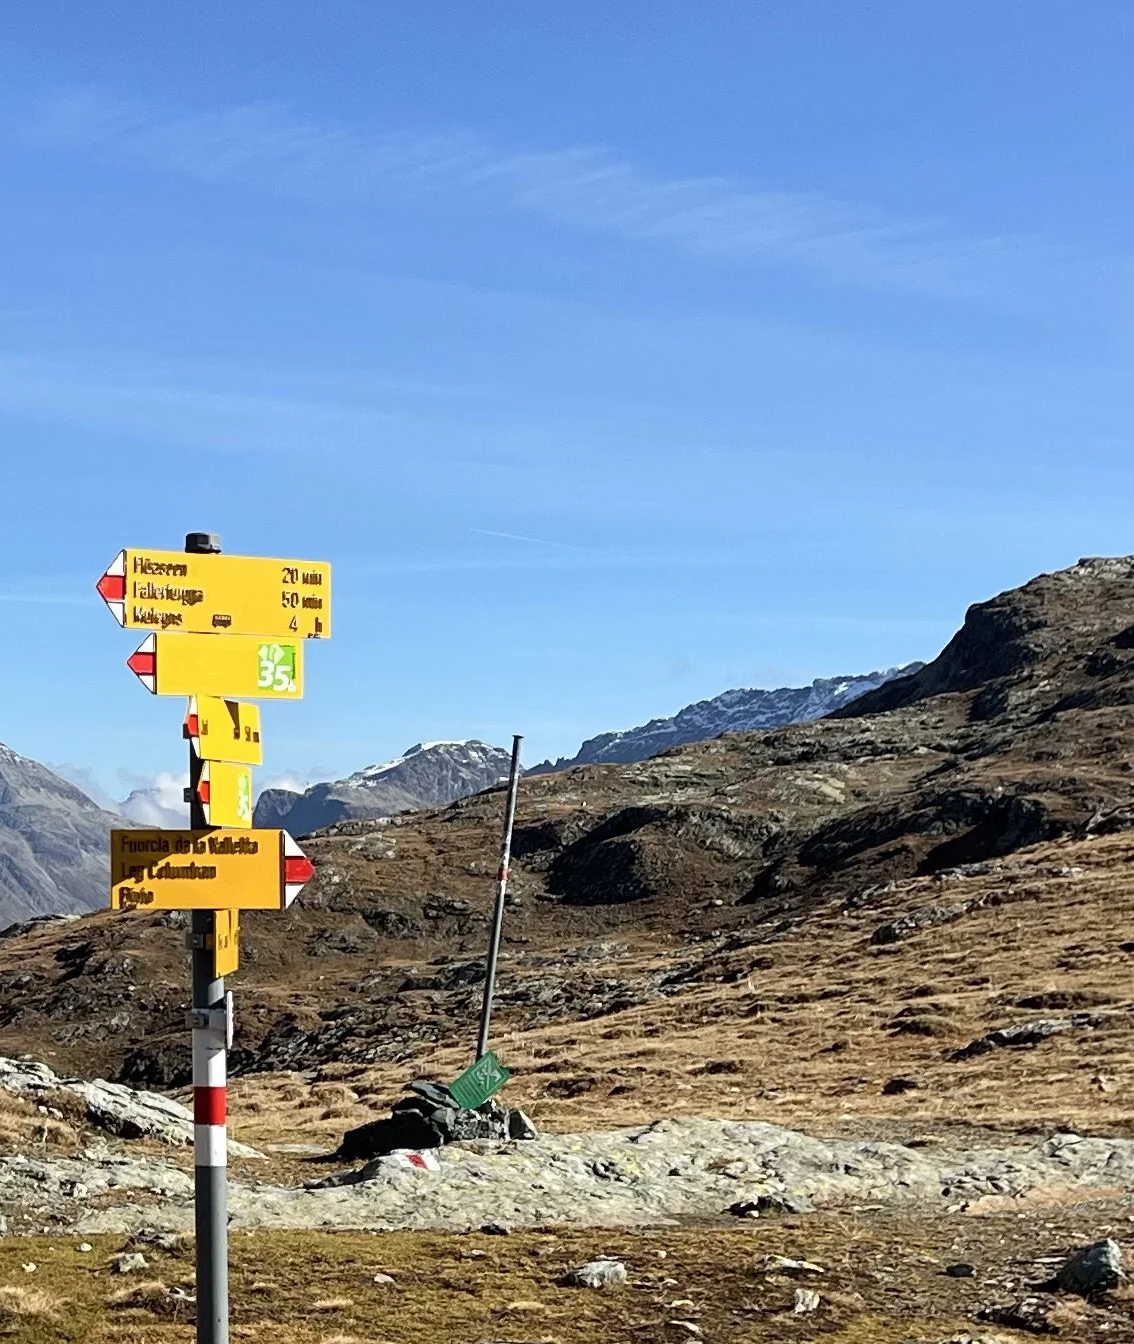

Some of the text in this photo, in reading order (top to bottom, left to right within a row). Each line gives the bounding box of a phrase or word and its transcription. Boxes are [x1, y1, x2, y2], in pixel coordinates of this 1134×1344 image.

[282, 567, 298, 584] 20
[282, 591, 299, 608] 50
[289, 615, 298, 632] 4
[257, 660, 289, 692] 35
